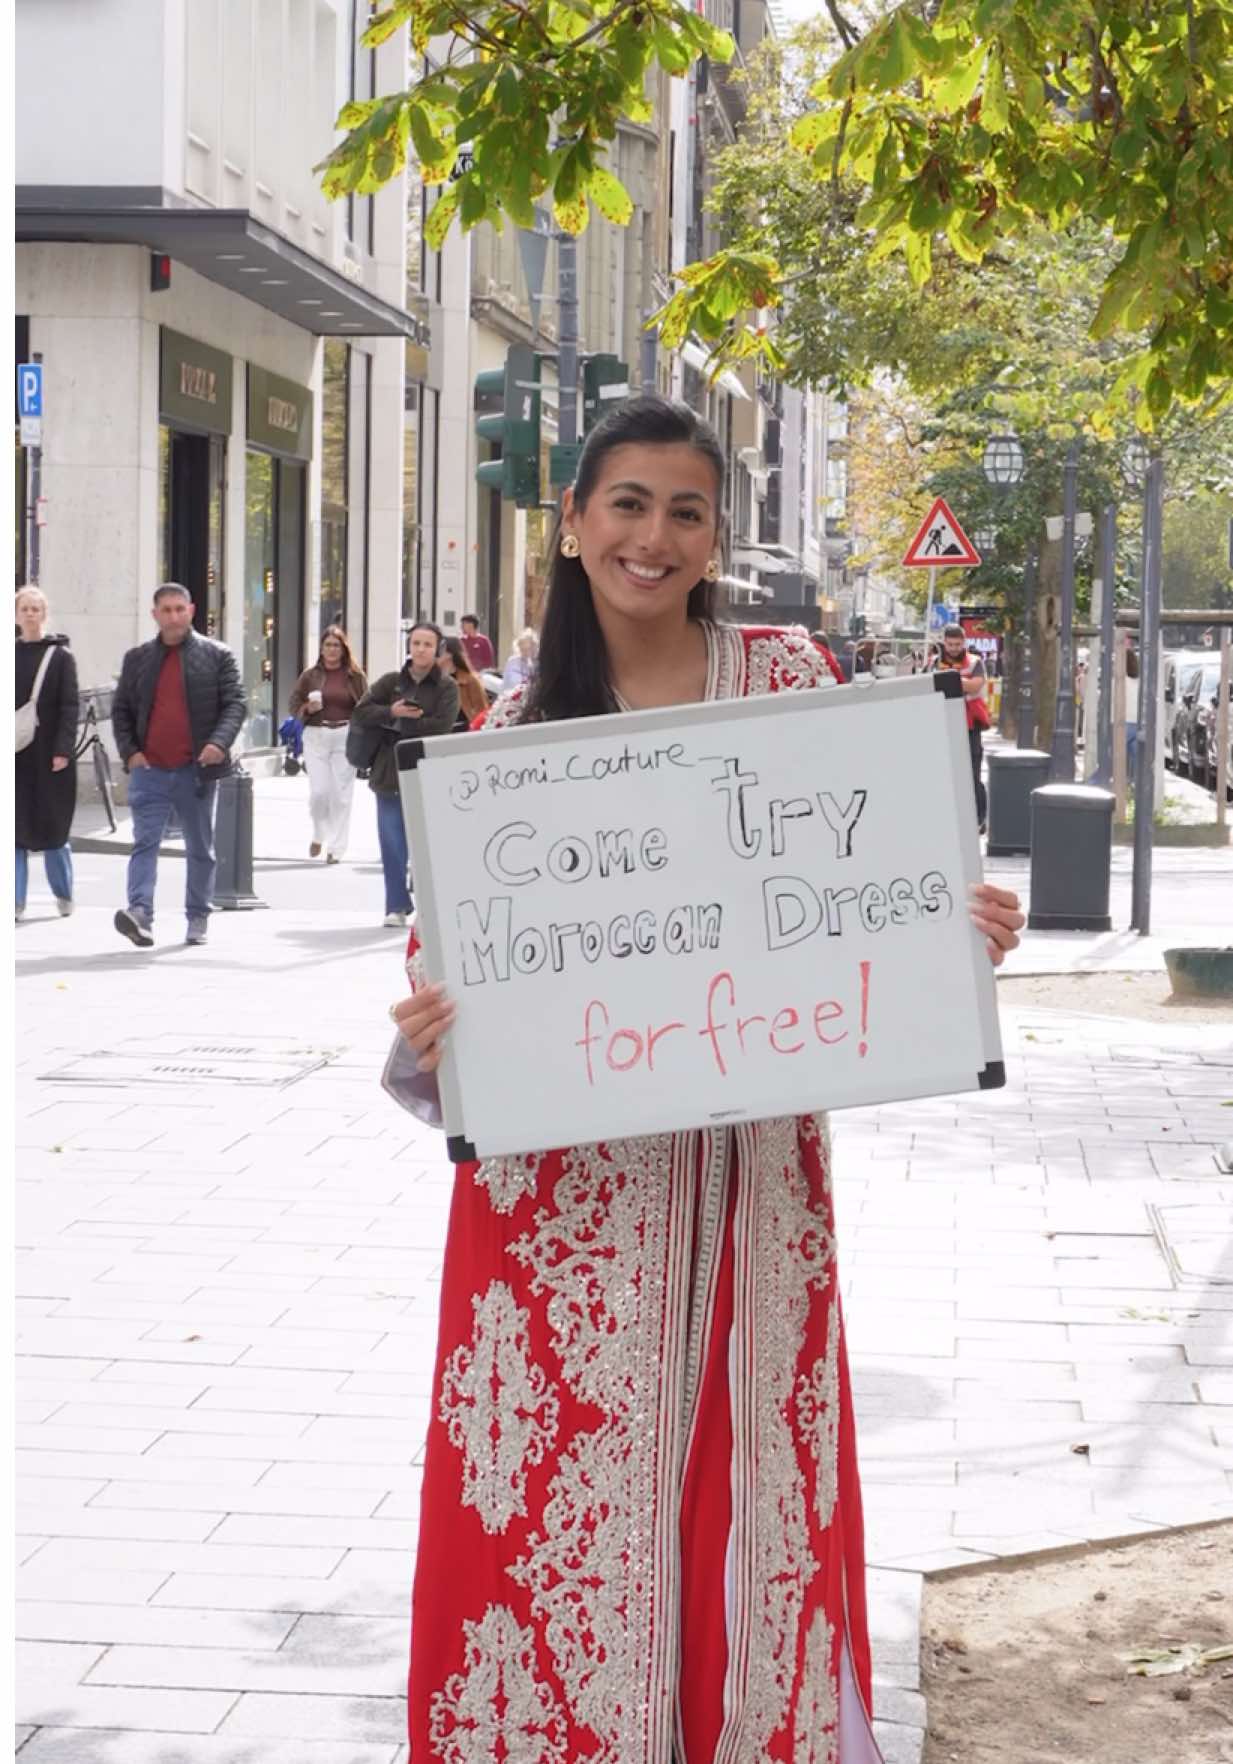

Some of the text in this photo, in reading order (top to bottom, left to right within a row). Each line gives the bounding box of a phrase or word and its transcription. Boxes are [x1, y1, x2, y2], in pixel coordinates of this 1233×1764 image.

[23, 371, 37, 412] P
[484, 820, 668, 886] Come
[456, 870, 952, 986] Moroccan Dress
[576, 960, 871, 1086] for free!
